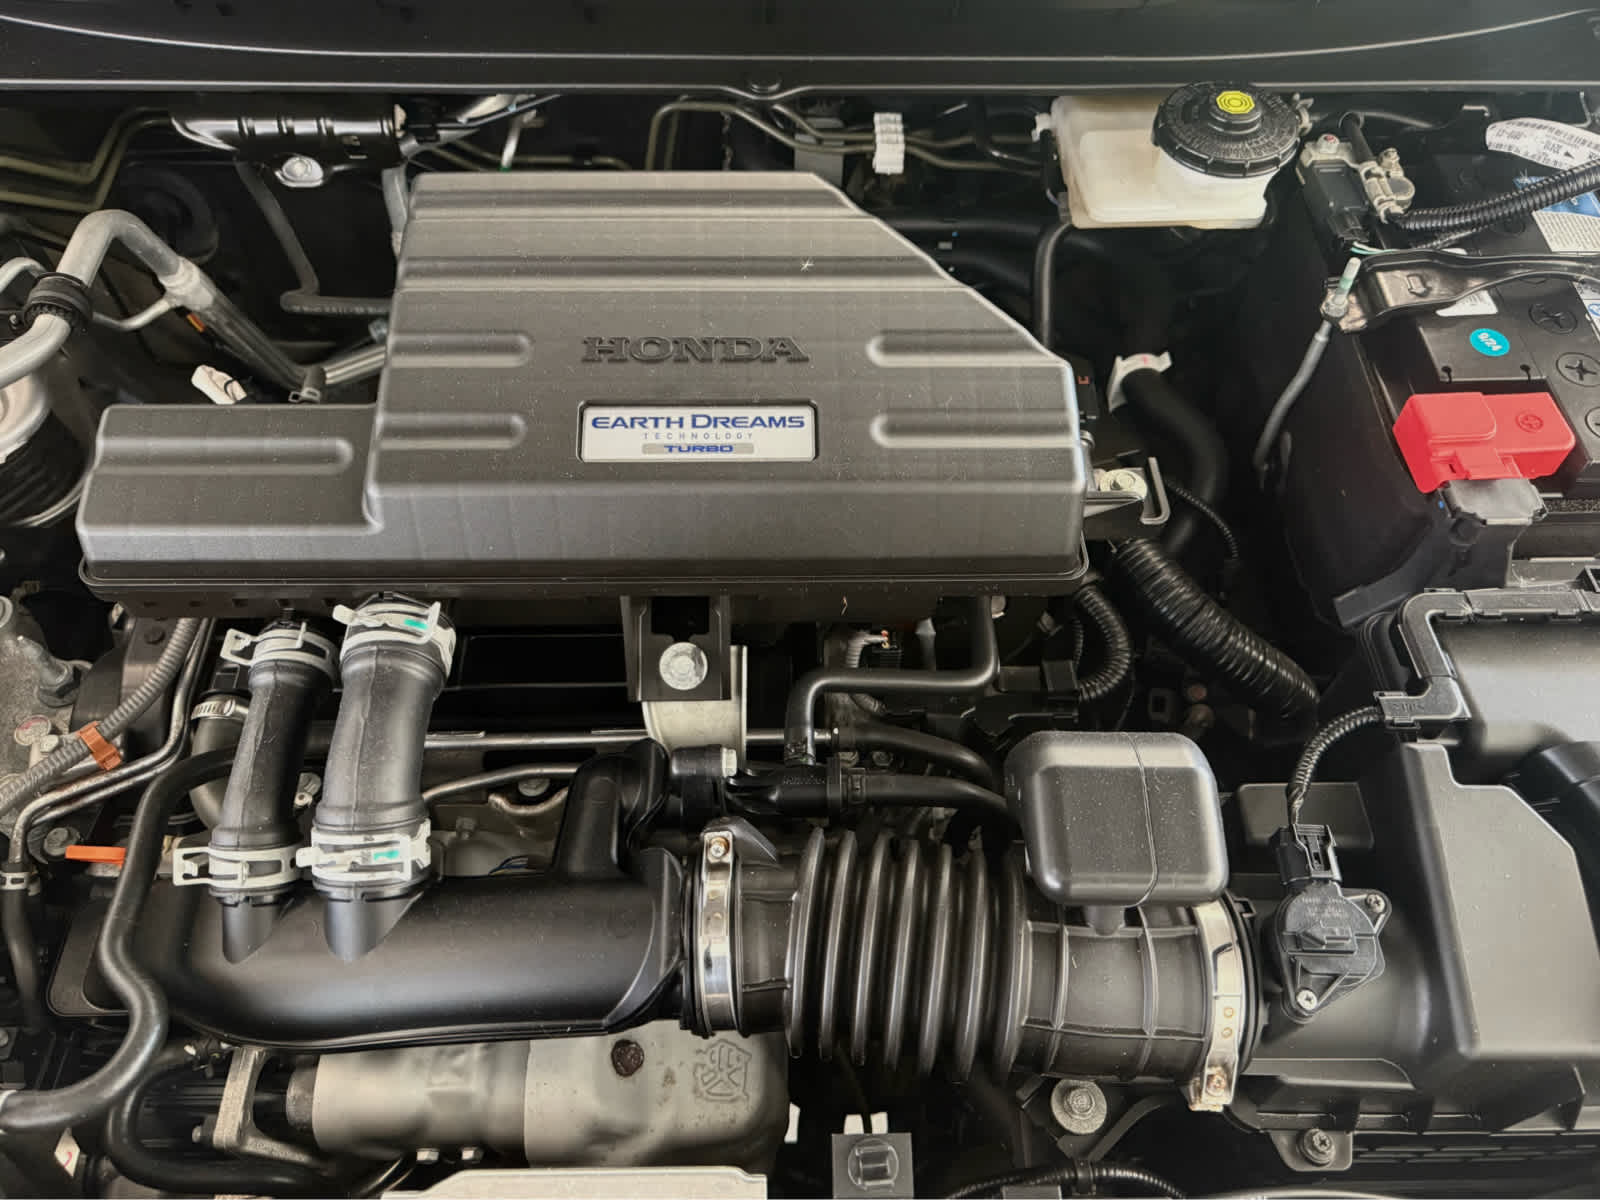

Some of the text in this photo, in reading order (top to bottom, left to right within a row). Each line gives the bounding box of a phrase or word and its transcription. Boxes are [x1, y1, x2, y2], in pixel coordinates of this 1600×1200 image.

[581, 336, 809, 363] HONDA
[591, 414, 805, 429] EARTH DREAMS
[644, 432, 753, 440] TECHNOLOGY
[663, 444, 734, 453] TURBO
